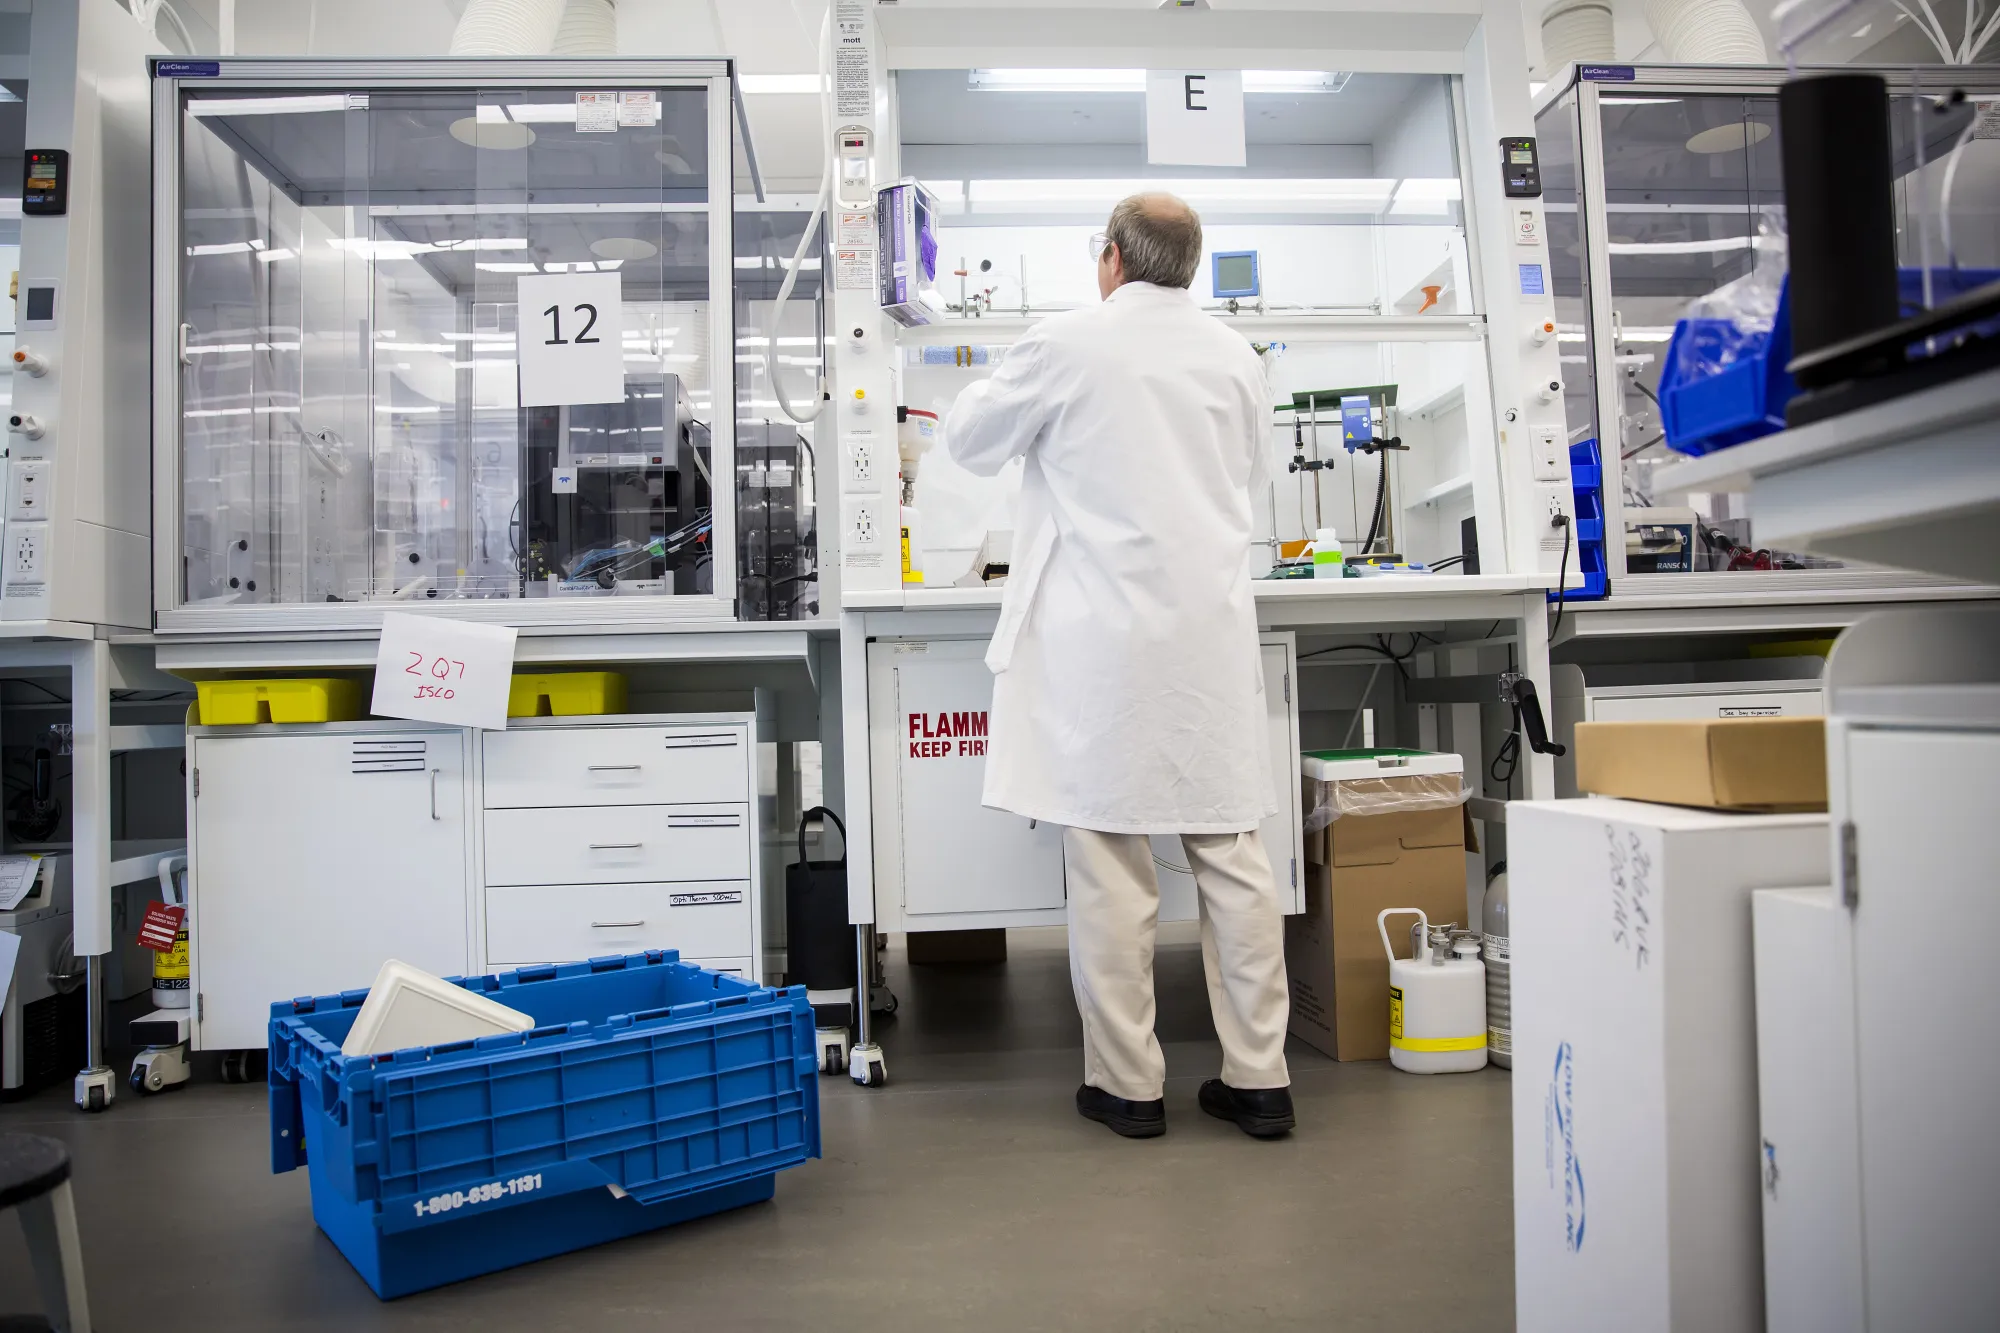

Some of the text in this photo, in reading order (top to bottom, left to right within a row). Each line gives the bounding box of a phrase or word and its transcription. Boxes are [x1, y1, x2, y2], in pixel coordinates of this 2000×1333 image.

[1184, 74, 1208, 111] E
[543, 303, 601, 345] 12
[413, 685, 455, 700] ISCO
[910, 739, 989, 758] KEEP FIR
[165, 914, 177, 922] WASTE
[166, 919, 178, 927] WASTE
[155, 979, 190, 989] 1E-122
